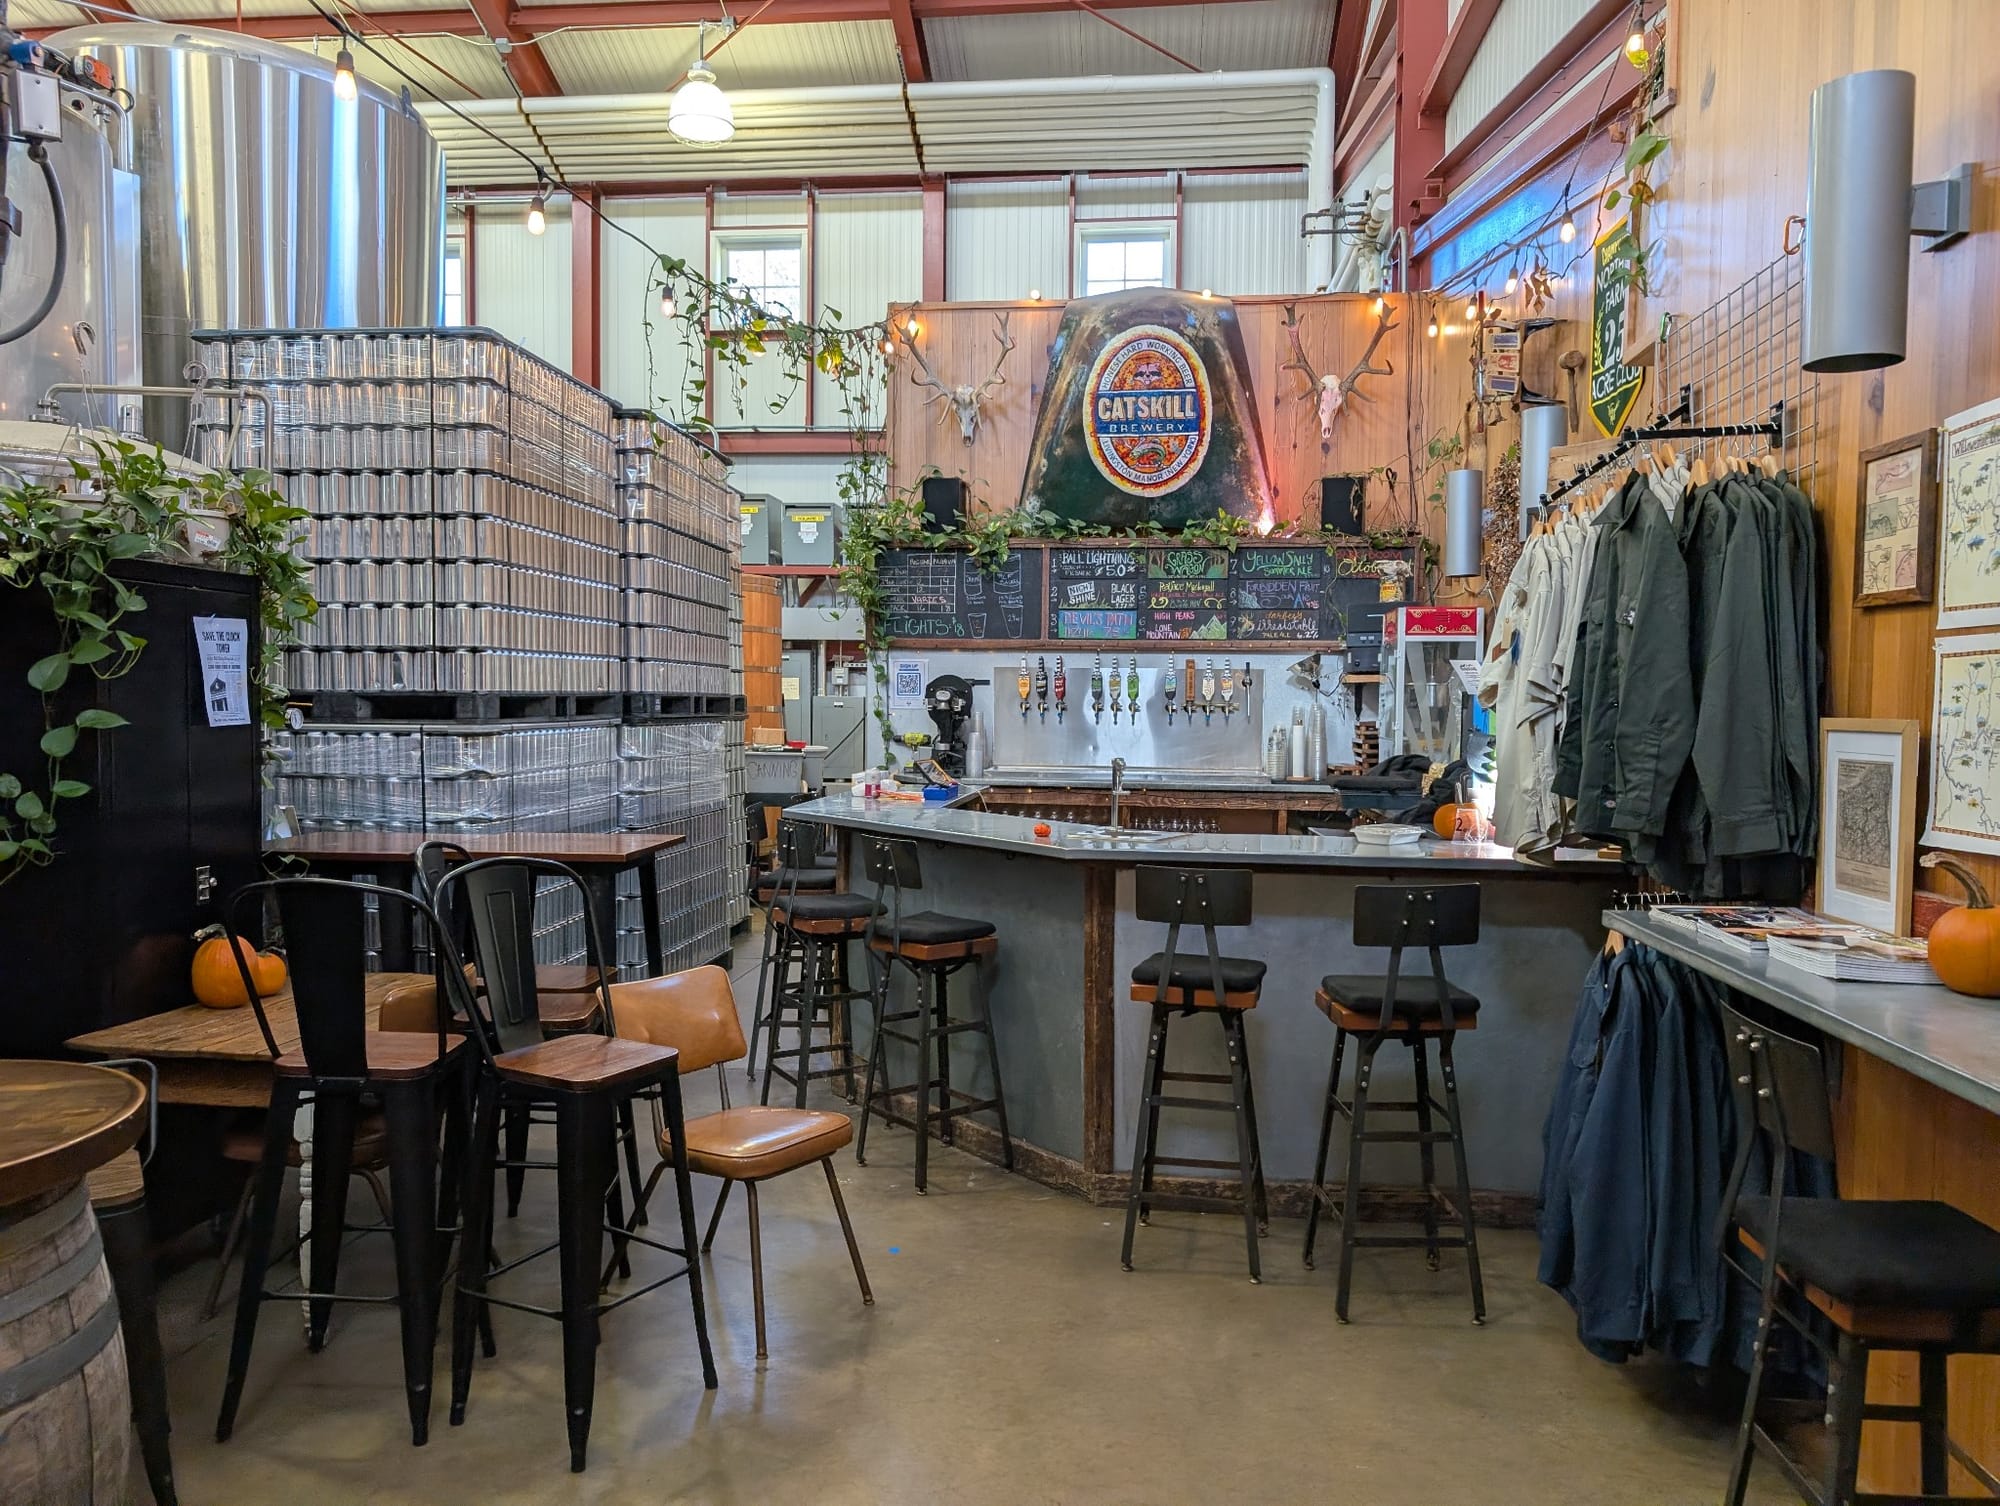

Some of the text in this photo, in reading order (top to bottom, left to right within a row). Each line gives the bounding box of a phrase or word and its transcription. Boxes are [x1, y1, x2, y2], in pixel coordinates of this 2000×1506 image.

[1103, 341, 1193, 389] HONEST HARD WORKING BEER
[1098, 394, 1197, 421] CATSKILL
[1109, 423, 1185, 433] BREWERY
[1102, 439, 1134, 478] LIVINGSTON
[1134, 473, 1164, 483] MANOR
[1062, 553, 1084, 565] BALL
[1167, 551, 1204, 566] GRASS
[1068, 581, 1095, 595] NIGHT
[1111, 583, 1136, 594] BLACK
[1069, 592, 1096, 604] SHINE
[1111, 594, 1136, 604] LAGER
[1155, 623, 1173, 632] LONE
[202, 631, 240, 641] SAVE THE CLOCK
[1146, 630, 1180, 639] MOUNTAIN
[215, 643, 230, 653] TOWER
